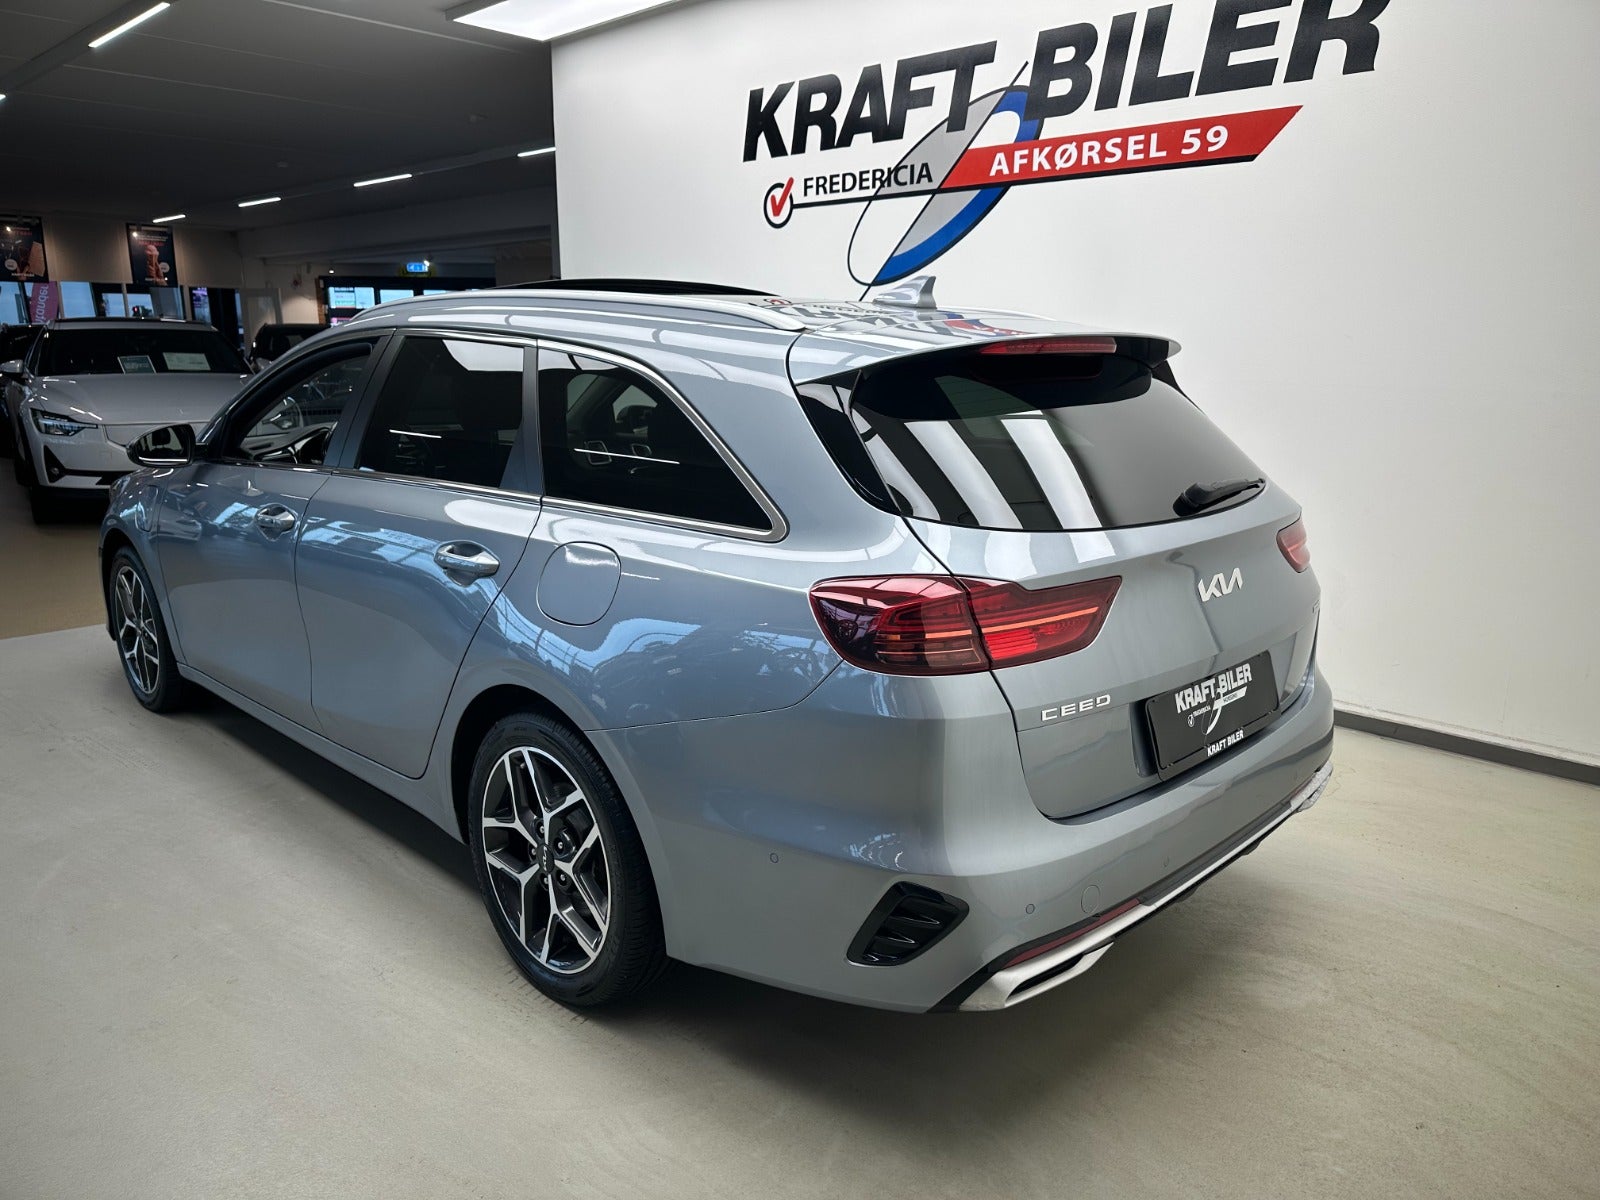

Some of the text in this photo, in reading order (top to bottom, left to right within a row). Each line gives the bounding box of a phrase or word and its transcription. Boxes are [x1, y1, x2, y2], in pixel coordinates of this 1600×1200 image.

[743, 0, 1391, 162] KRAFT BILER
[989, 125, 1229, 177] AFKØRSEL 59
[803, 162, 933, 197] FREDERICIA
[1041, 694, 1111, 722] CEED
[1175, 663, 1252, 713] KRAFT BILER
[1207, 729, 1244, 757] KRAFT BILER
